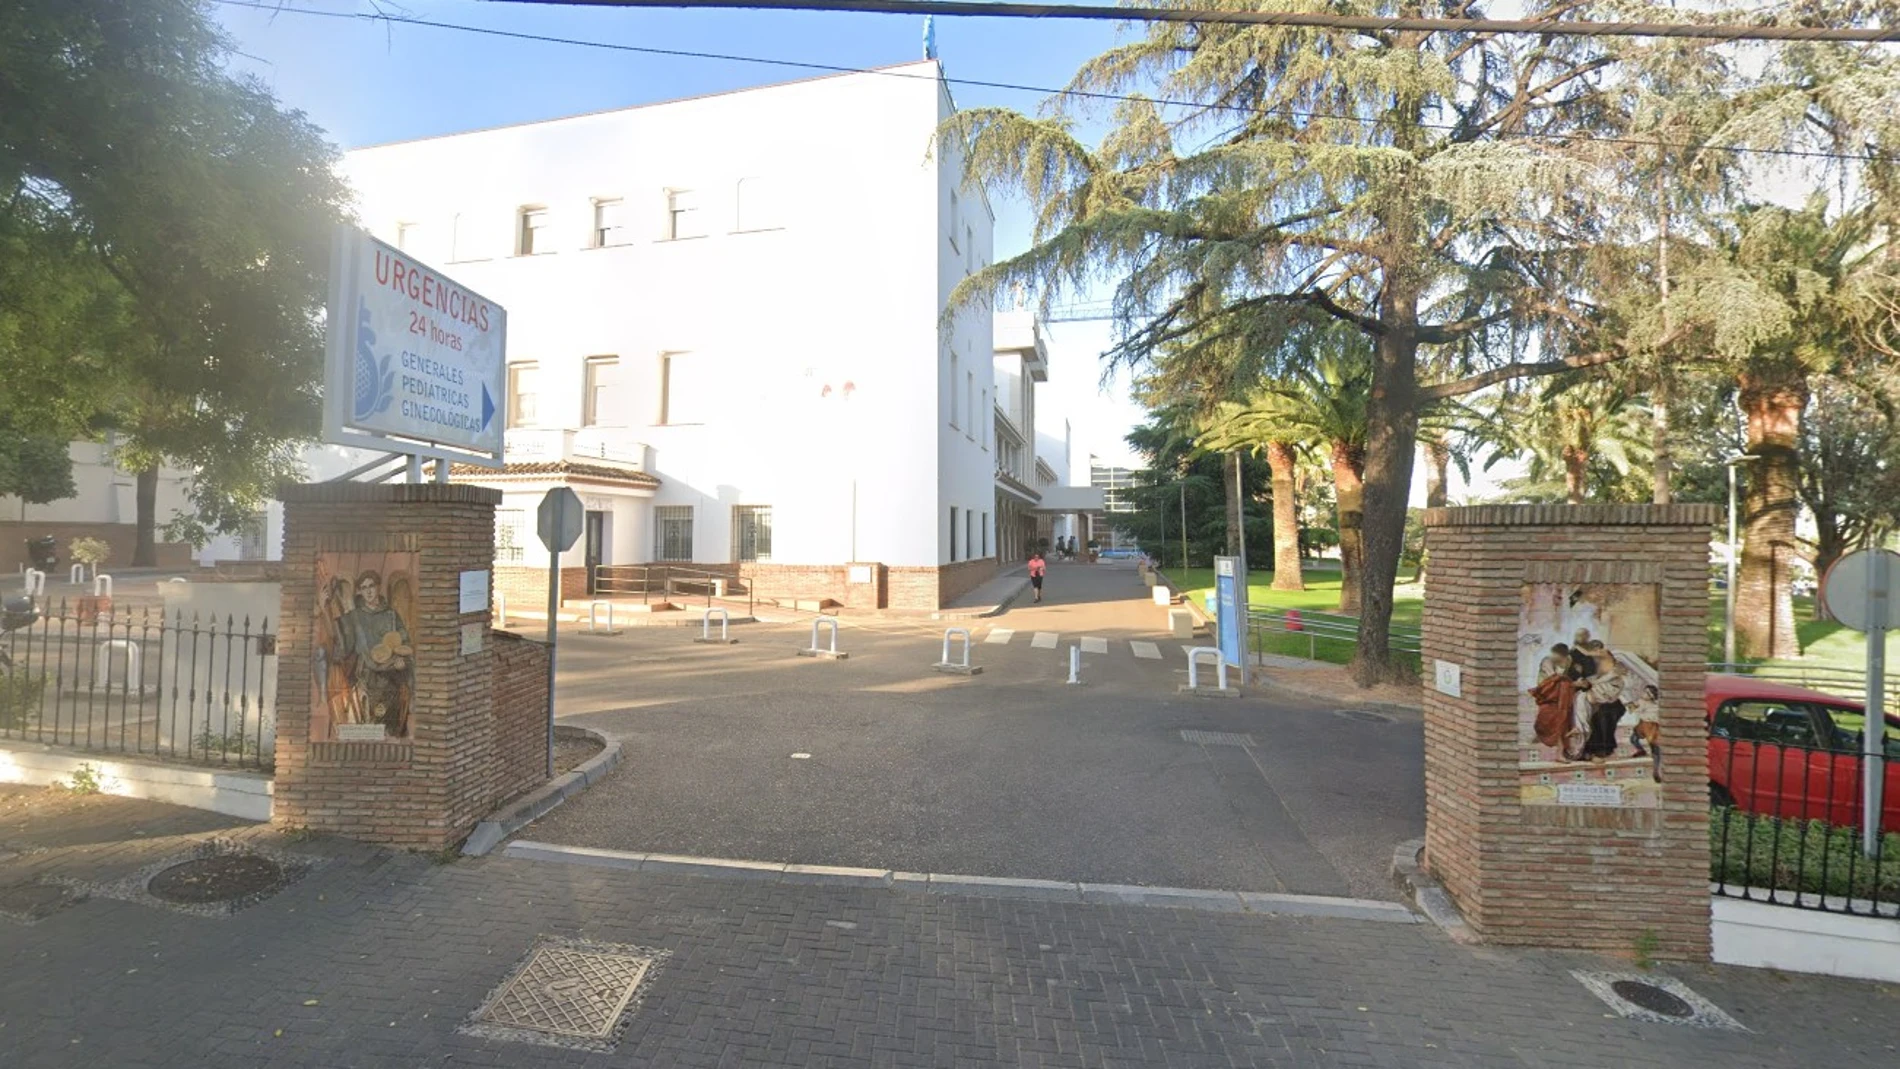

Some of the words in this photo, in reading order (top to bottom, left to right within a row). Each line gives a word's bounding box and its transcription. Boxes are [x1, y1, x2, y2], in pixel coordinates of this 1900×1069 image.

[376, 250, 489, 332] URGENCIAS
[409, 311, 426, 337] 24
[430, 320, 462, 351] horas
[402, 351, 464, 385] GENERALES
[402, 400, 481, 433] GINECOLÓGICAS
